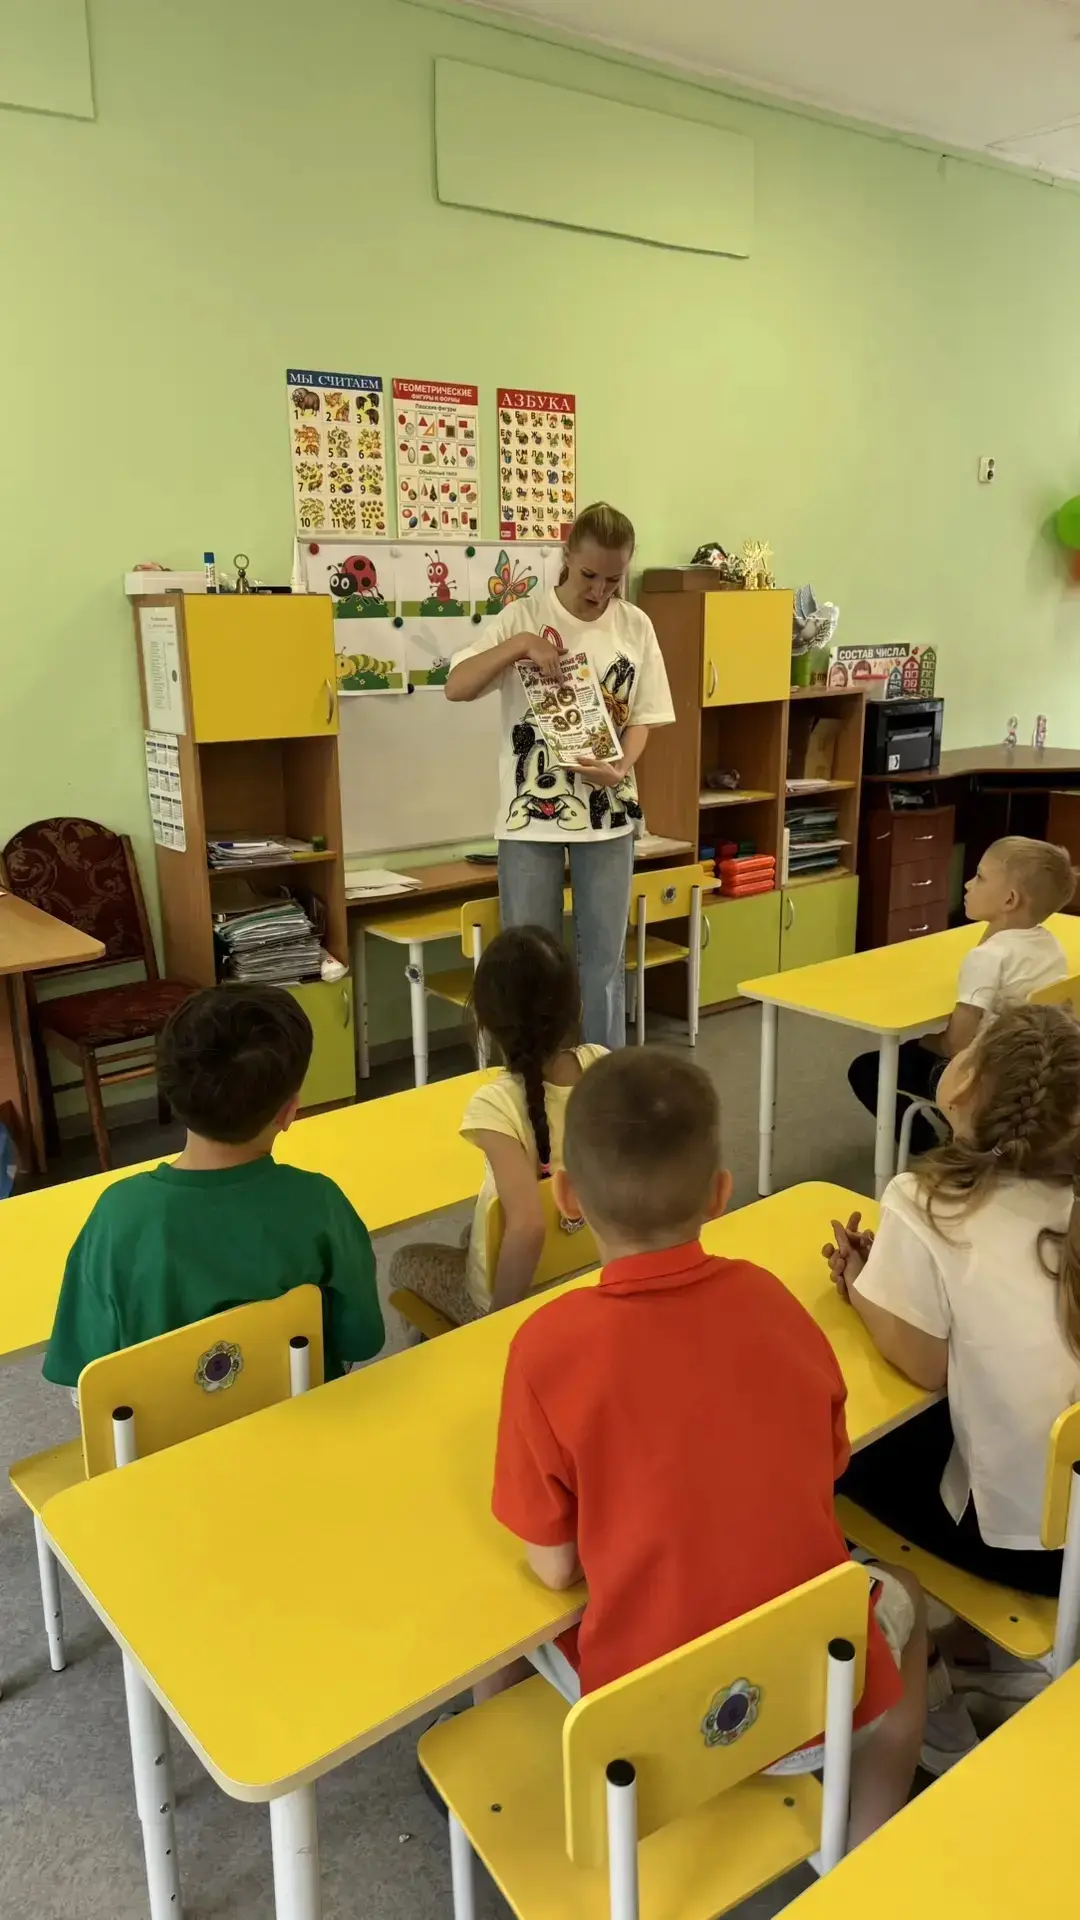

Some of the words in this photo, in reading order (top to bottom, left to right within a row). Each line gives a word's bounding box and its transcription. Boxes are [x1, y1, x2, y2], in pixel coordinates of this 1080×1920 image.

[289, 373, 314, 384] МЫ
[318, 375, 380, 389] СЧИТАЕМ
[398, 382, 473, 397] ГЕОМЕТРИЧЕСКИЕ
[501, 392, 571, 411] АЗБУКА
[294, 409, 299, 420] 1
[326, 411, 332, 422] 2
[356, 413, 362, 424] 3
[295, 446, 301, 456] 4
[328, 447, 334, 457] 5
[358, 449, 364, 459] 6
[298, 482, 304, 492] 7
[330, 483, 336, 493] 8
[360, 484, 366, 494] 9
[300, 517, 311, 528] 10
[331, 518, 340, 528] 11
[361, 519, 371, 529] 12
[839, 648, 874, 660] СОСТАВ
[875, 647, 907, 658] ЧИСЛА
